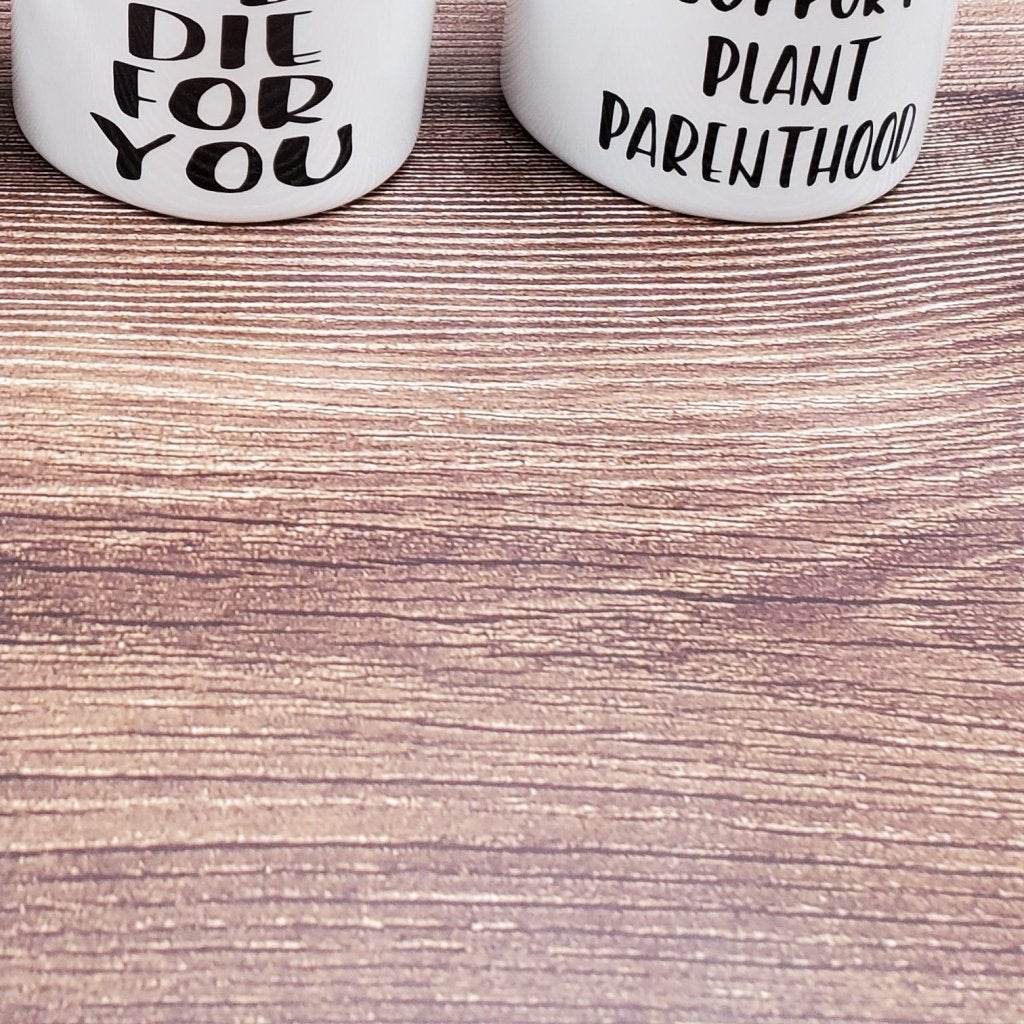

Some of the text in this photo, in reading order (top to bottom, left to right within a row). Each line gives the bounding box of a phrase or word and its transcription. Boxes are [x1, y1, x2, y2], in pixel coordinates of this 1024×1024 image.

[127, 2, 322, 70] DIE
[702, 35, 883, 107] PLANT
[112, 60, 334, 131] FOR
[89, 111, 354, 194] YOU
[598, 90, 918, 189] PARENTHOOD
